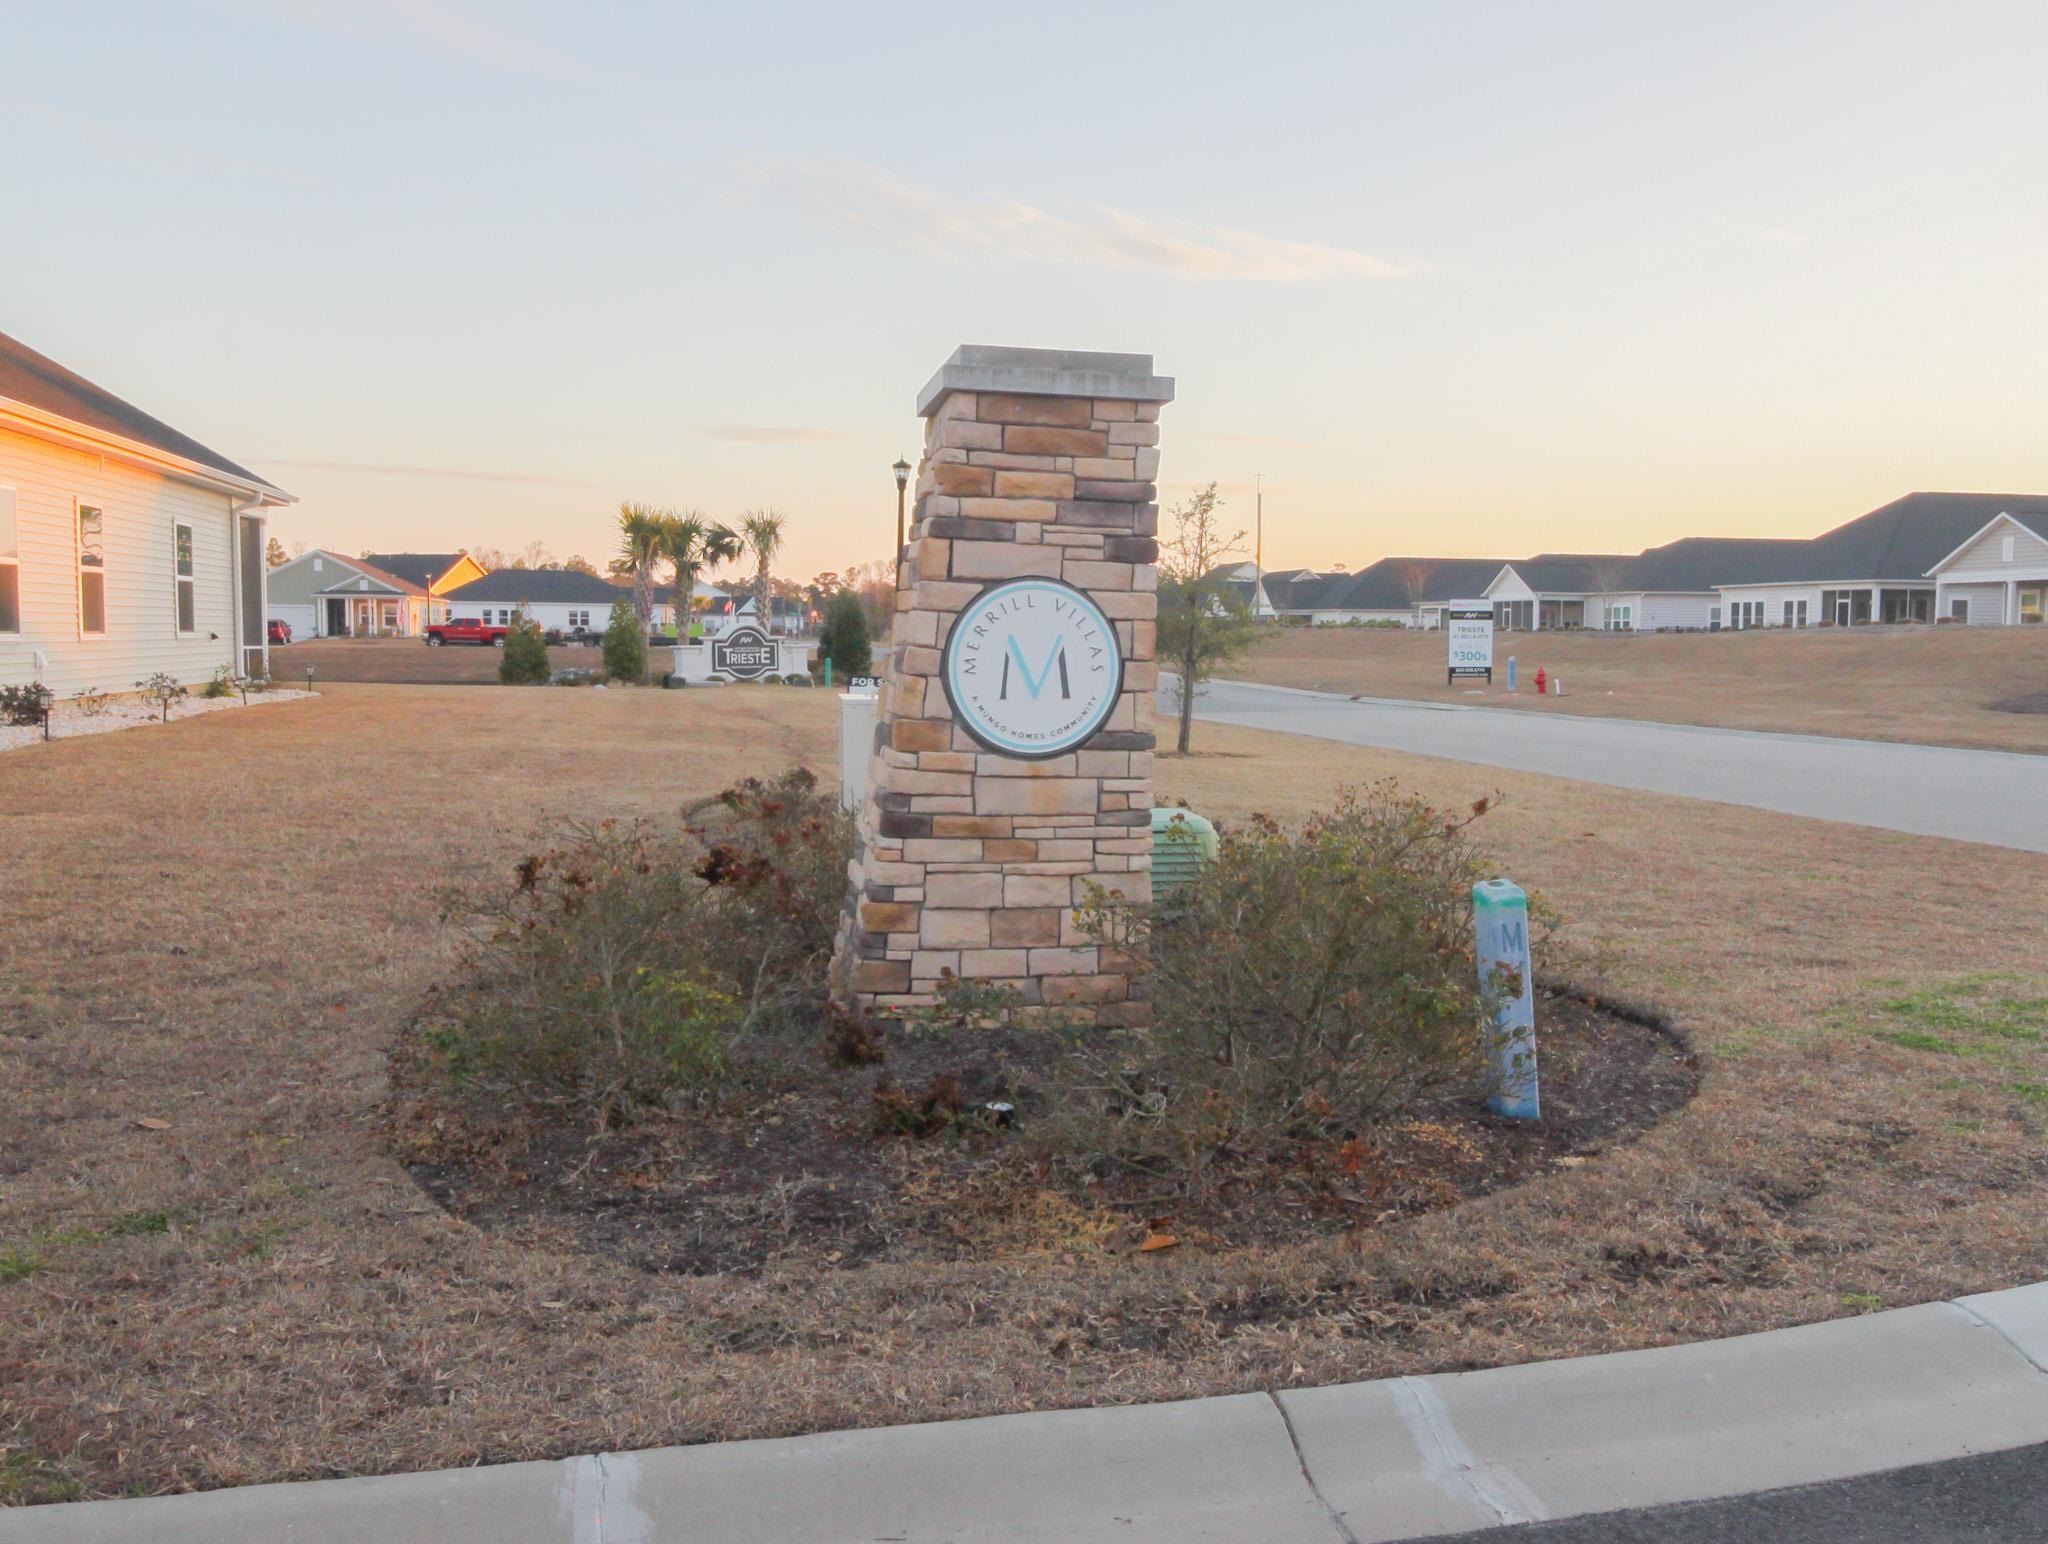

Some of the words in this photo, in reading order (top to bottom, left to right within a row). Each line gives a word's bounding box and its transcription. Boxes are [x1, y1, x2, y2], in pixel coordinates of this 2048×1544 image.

[963, 594, 1035, 675] MERRILL
[1055, 598, 1104, 672] VILLAS
[722, 647, 771, 665] TRIESTE
[851, 677, 875, 686] FOR
[977, 704, 1007, 732] MUNGO
[1011, 729, 1045, 740] HOMES
[1050, 695, 1097, 737] COMMUNITY
